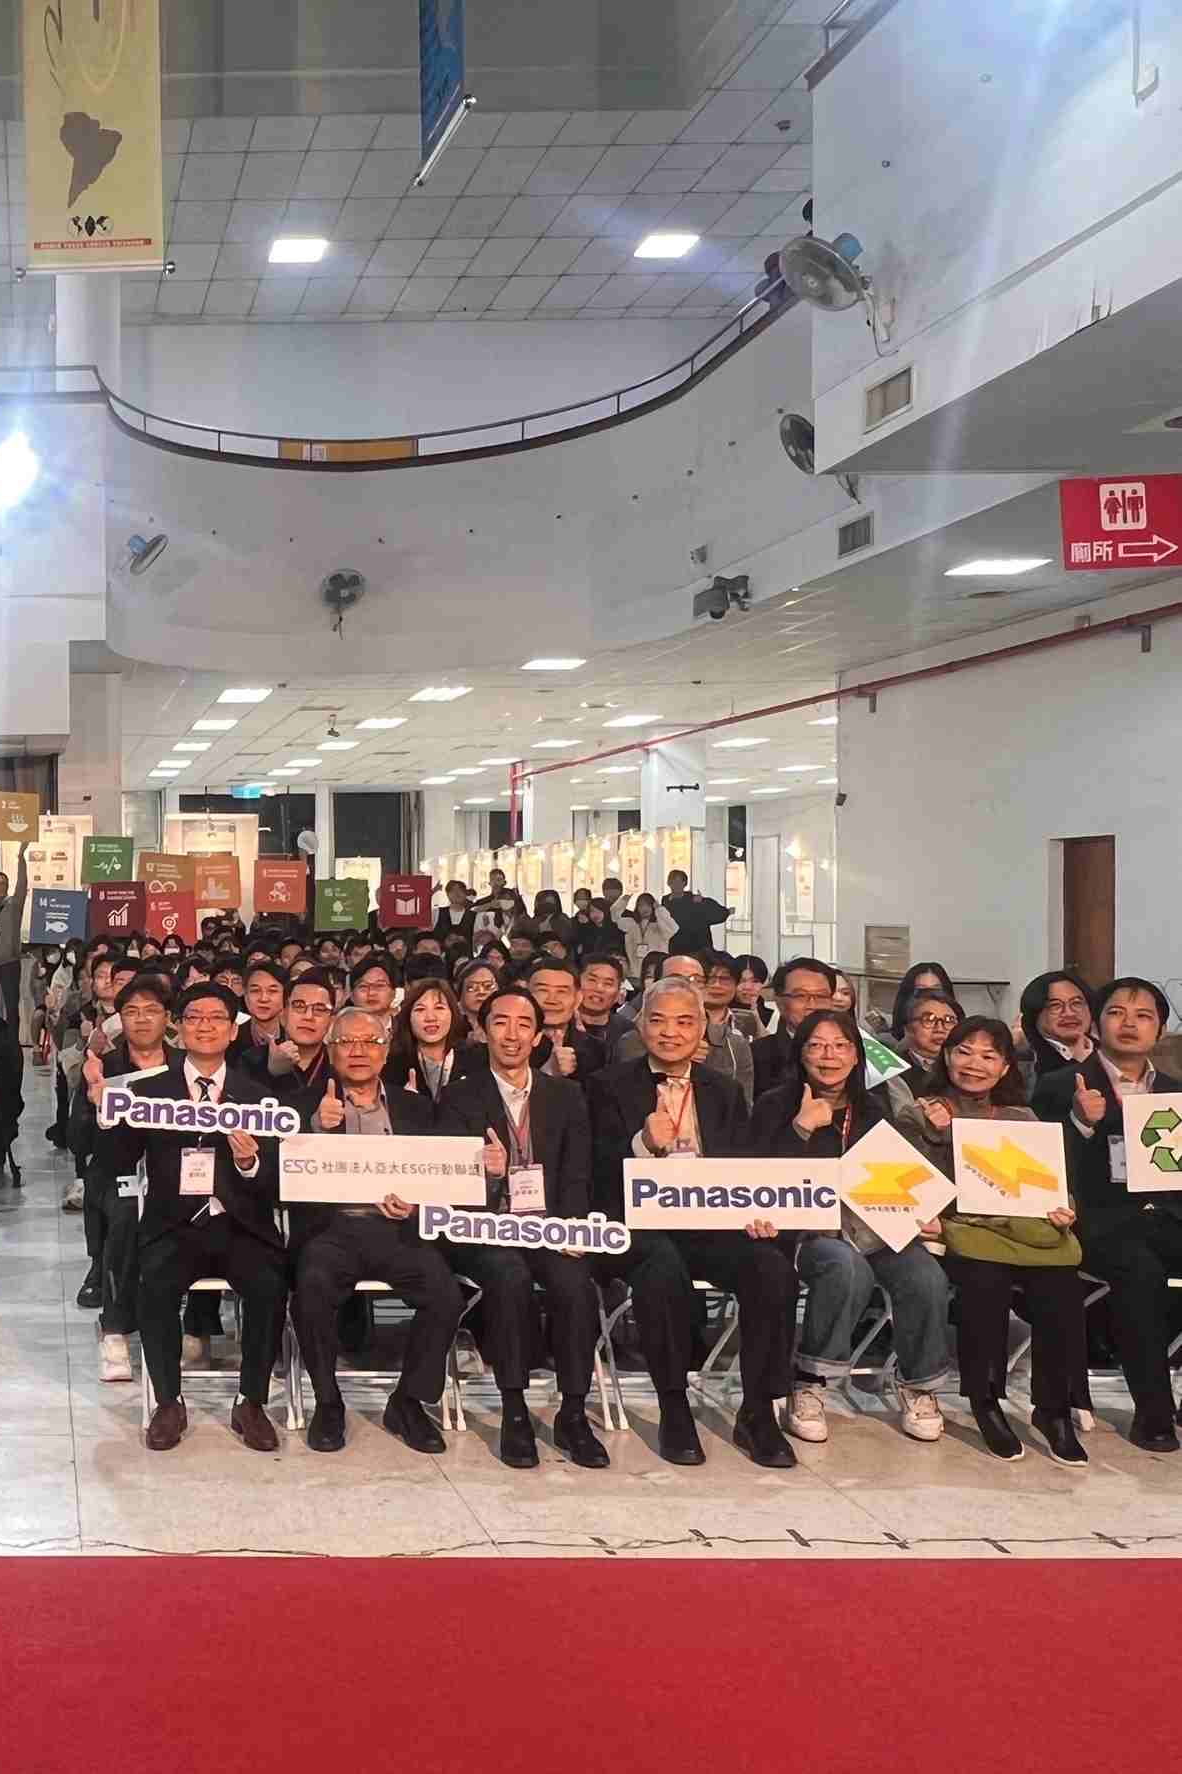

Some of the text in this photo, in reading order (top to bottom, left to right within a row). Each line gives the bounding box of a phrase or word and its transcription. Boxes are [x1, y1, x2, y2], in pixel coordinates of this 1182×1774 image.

[1070, 540, 1114, 563] 廁所
[106, 1092, 295, 1132] Panasonic
[283, 1159, 318, 1175] ESG
[632, 1178, 836, 1209] Panasonic
[424, 1205, 626, 1249] Panasonic
